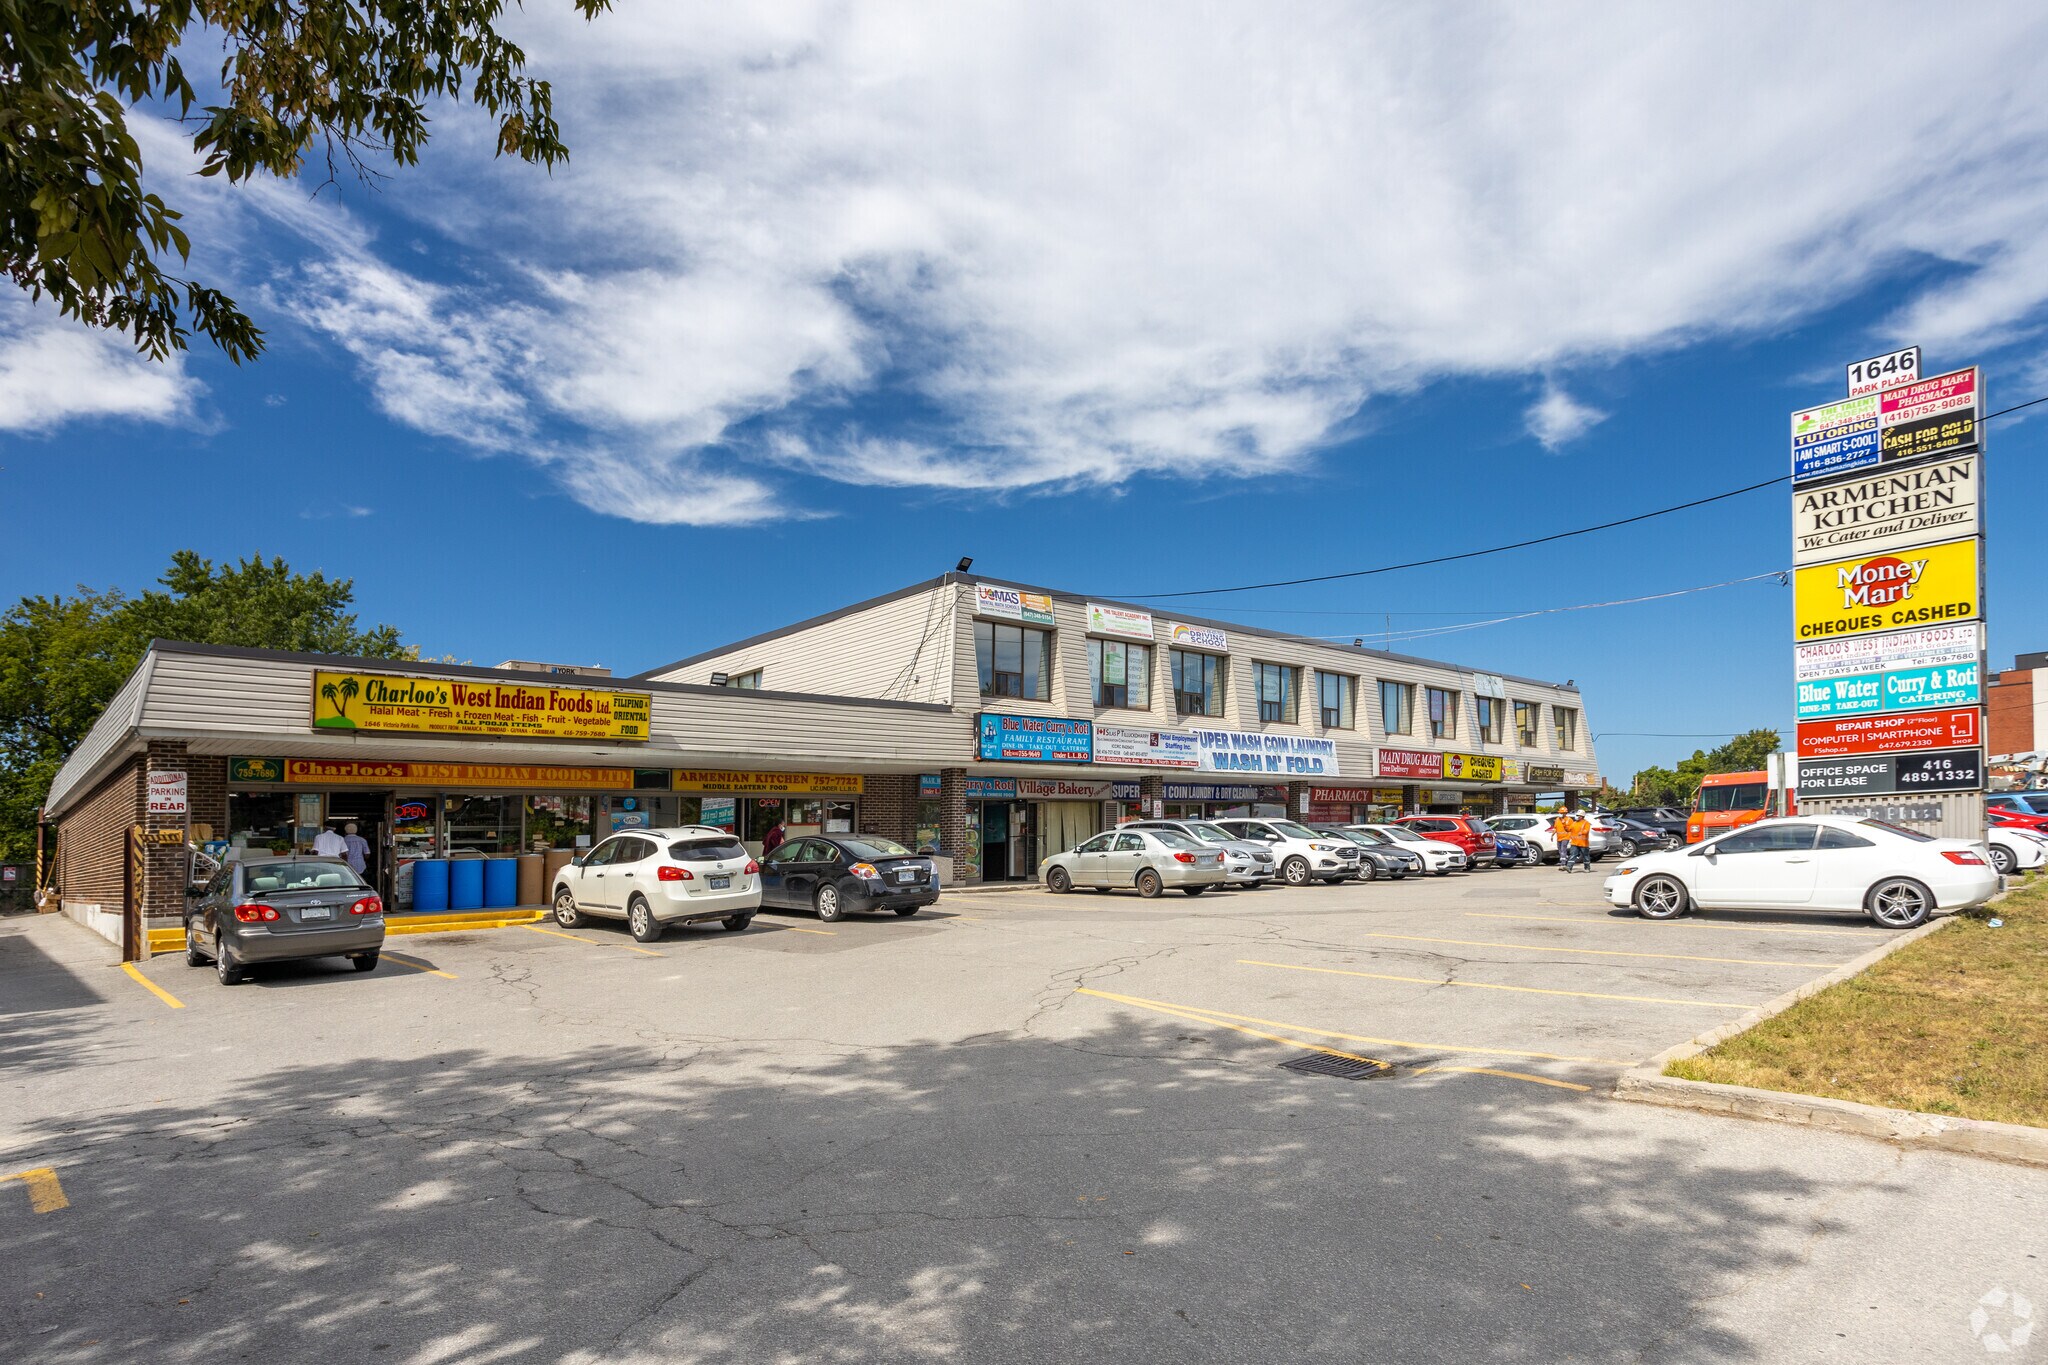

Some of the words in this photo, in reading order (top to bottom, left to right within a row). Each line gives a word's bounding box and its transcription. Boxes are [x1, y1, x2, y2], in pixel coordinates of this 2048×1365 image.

[1851, 351, 1915, 383] 1646
[1852, 382, 1878, 396] PARK
[1881, 373, 1915, 389] PLAZA
[1883, 388, 1909, 402] MAIN
[1910, 381, 1939, 397] DRUG
[1940, 372, 1972, 388] MART
[1897, 386, 1956, 408] PHARMACY
[1820, 406, 1837, 417] THE
[1841, 396, 1876, 410] TALENT
[1884, 395, 1971, 425] (416)752-9088
[1819, 411, 1877, 430] 647-348-5154
[1796, 419, 1877, 446] TUTORING
[1883, 432, 1913, 451] CASH
[1915, 427, 1939, 444] FOR
[1941, 419, 1973, 438] GOLD
[1799, 448, 1813, 461] AM
[1813, 441, 1843, 458] SMART
[1842, 433, 1877, 451] S-COOL!
[1803, 449, 1871, 470] 416-836-2727
[1800, 462, 1972, 514] ARMENIAN
[1813, 487, 1956, 530] KITCHEN
[1803, 537, 1823, 550] We
[1827, 528, 1870, 544] Cater
[1872, 518, 1904, 537] and
[1908, 510, 1968, 531] Deliver
[1836, 558, 1929, 588] Money
[1843, 581, 1914, 609] Mart
[1800, 614, 1883, 637] CHEQUES
[1892, 602, 1972, 625] CASHED
[1190, 630, 1225, 642] DRIVING
[1191, 637, 1226, 648] SCHOOL
[1800, 641, 1850, 659] CHARLOO'S
[1853, 638, 1878, 652] WEST
[1881, 633, 1917, 648] INDIAN
[1921, 628, 1955, 643] FOODS
[1930, 653, 1974, 664] 759-7680
[557, 667, 575, 675] YORK
[1799, 671, 1820, 679] OPEN
[1829, 667, 1851, 675] DAYS
[1861, 663, 1886, 671] WEEK
[1799, 683, 1831, 703] Blue
[1834, 680, 1879, 700] Water
[1887, 675, 1927, 695] Curry
[1930, 670, 1943, 689] &
[1946, 666, 1978, 688] Roti
[365, 679, 448, 705] Charloo's
[451, 683, 491, 708] West
[495, 687, 545, 711] Indian
[549, 690, 593, 714] Foods
[596, 700, 612, 714] Ltd.
[613, 697, 643, 709] FILIPINO
[1898, 690, 1966, 704] CATERING
[1799, 703, 1831, 714] DINE-IN
[1836, 699, 1879, 710] TAKE-OUT
[370, 706, 394, 715] Halal
[396, 707, 420, 717] Meat
[429, 708, 453, 718] Fresh
[463, 711, 492, 721] Frozen
[494, 712, 514, 722] Meat
[522, 713, 539, 722] Fish
[547, 715, 566, 724] Fruit
[573, 716, 611, 727] Vegetable
[613, 711, 647, 722] ORIENTAL
[620, 725, 639, 735] FOOD
[1002, 717, 1020, 731] Blue
[1022, 719, 1044, 732] Water
[1045, 720, 1066, 736] Curry
[1073, 722, 1089, 735] Roti
[1835, 721, 1873, 732] REPAIR
[1874, 718, 1905, 729] SHOP
[1004, 734, 1035, 743] FAMILY
[1036, 735, 1087, 745] RESTAURANT
[1171, 734, 1198, 744] Employment
[1192, 730, 1230, 749] UPER
[1230, 733, 1262, 751] WASH
[1264, 736, 1288, 753] COIN
[1290, 738, 1334, 757] LAUNDRY
[1802, 734, 1859, 746] COMPUTER
[1867, 727, 1943, 741] SMARTPHONE
[1878, 739, 1933, 749] 647.679.2330
[1165, 743, 1183, 751] Staffing
[1212, 752, 1263, 771] WASH
[1265, 755, 1282, 772] N'
[1286, 756, 1324, 773] FOLD
[1380, 751, 1401, 764] MAIN
[1401, 752, 1420, 765] DRUG
[1421, 754, 1441, 767] MART
[1470, 757, 1495, 768] CHEQUES
[1923, 759, 1952, 770] 416
[238, 768, 275, 778] 759-7680
[292, 762, 403, 777] Charloo's
[410, 763, 461, 778] WEST
[467, 765, 531, 780] INDIAN
[536, 767, 592, 781] FOODS
[597, 769, 630, 782] LTD.
[1391, 765, 1409, 774] Delivery
[1471, 768, 1493, 779] CASHED
[1531, 768, 1543, 777] CASH
[1543, 769, 1552, 777] FOR
[1801, 766, 1843, 778] OFFICE
[1845, 764, 1888, 775] SPACE
[1901, 769, 1975, 783] 489.1332
[150, 772, 186, 784] ADDITIONAL
[679, 771, 750, 783] ARMENIAN
[755, 773, 809, 784] KITCHEN
[813, 776, 858, 785] 757-7722
[966, 778, 984, 792] urry
[994, 778, 1015, 791] Roti
[1801, 778, 1826, 789] FOR
[1828, 776, 1867, 787] LEASE
[150, 788, 185, 796] PARKING
[1018, 779, 1055, 796] Village
[1058, 782, 1094, 798] Bakery
[1112, 784, 1140, 798] SUPER
[1168, 785, 1188, 799] COIN
[1188, 786, 1215, 799] LAUNDRY
[1215, 787, 1220, 799] &
[1221, 786, 1232, 800] DRY
[1232, 787, 1258, 800] CLEANING
[1314, 789, 1369, 801] PHARMACY
[150, 802, 185, 810] REAR
[758, 799, 780, 807] OPEN
[394, 805, 427, 817] OPEN
